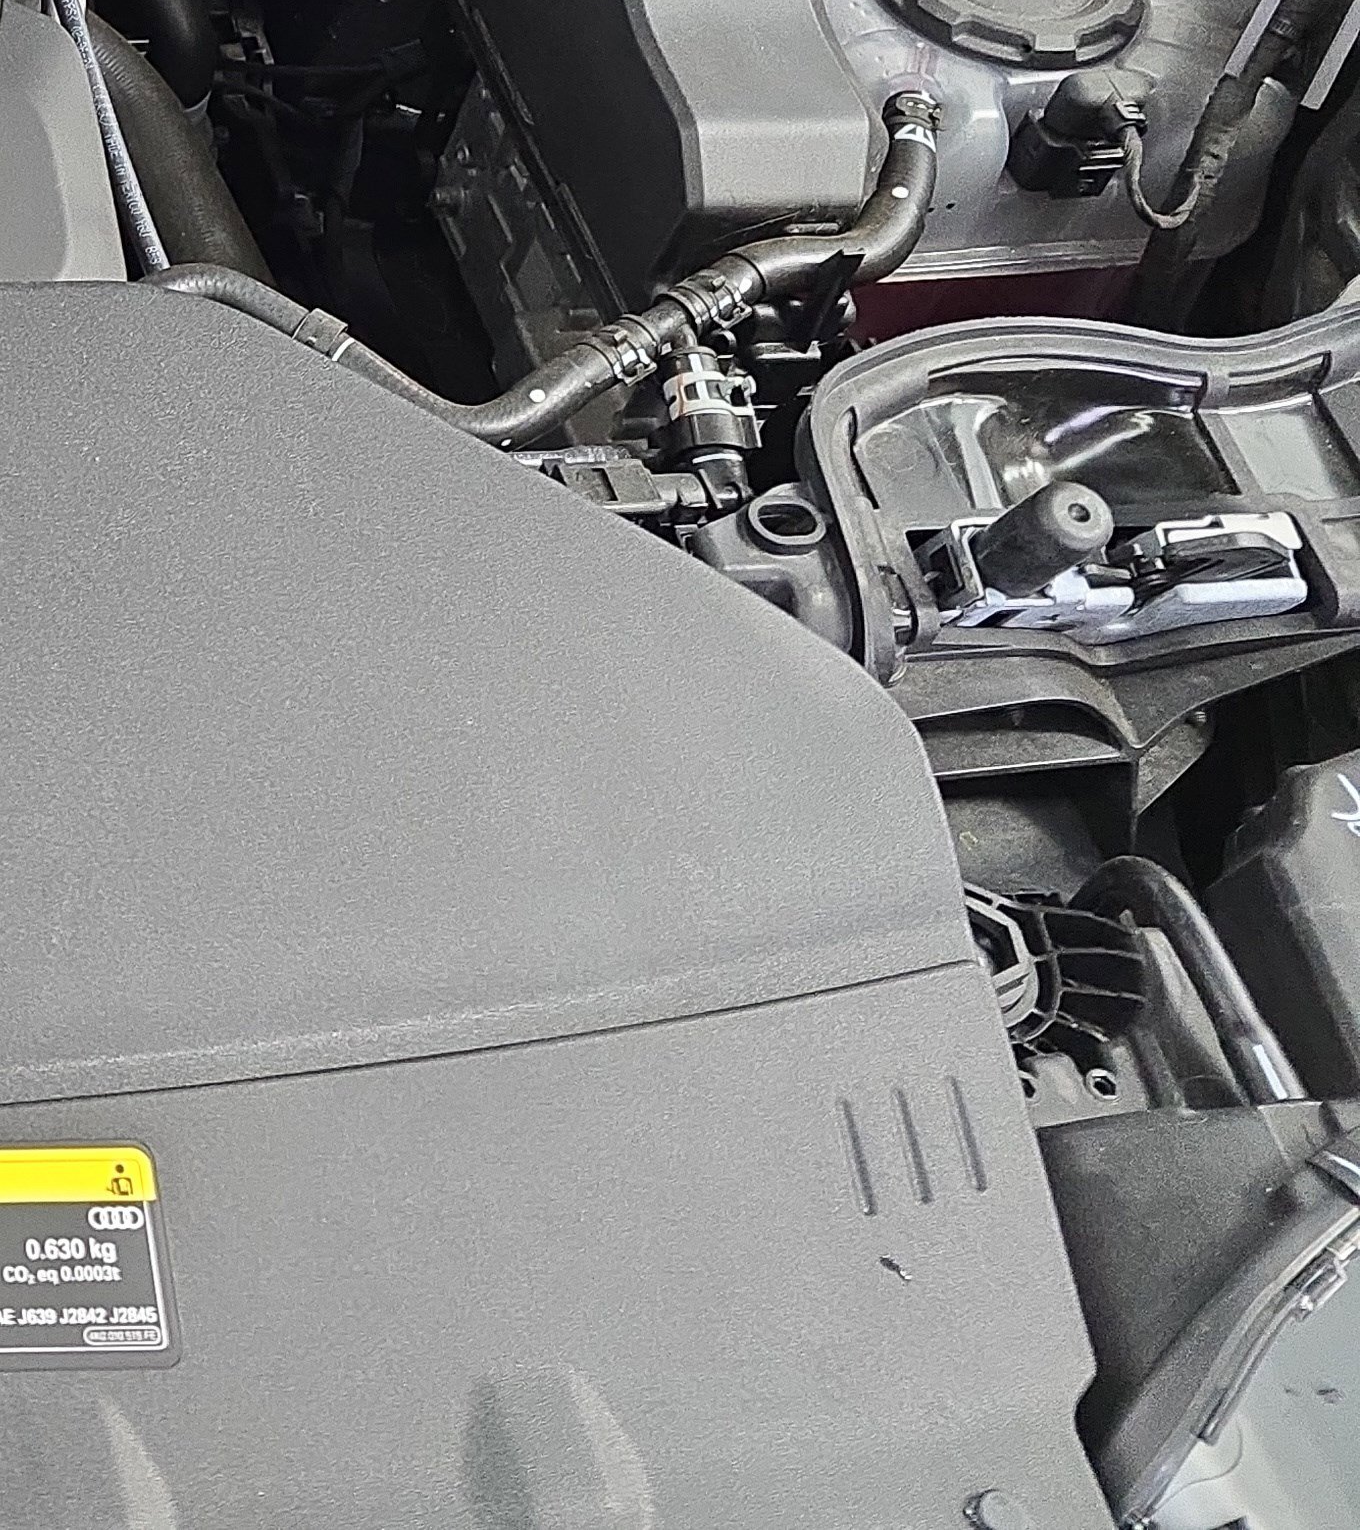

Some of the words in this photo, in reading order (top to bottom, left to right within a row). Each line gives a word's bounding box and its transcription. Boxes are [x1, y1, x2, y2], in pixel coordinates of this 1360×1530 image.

[25, 1237, 86, 1260] 0.630
[89, 1237, 118, 1264] kg
[37, 1269, 60, 1285] eq
[17, 1307, 57, 1325] J639
[60, 1307, 108, 1325] J2842
[109, 1306, 158, 1324] J2845
